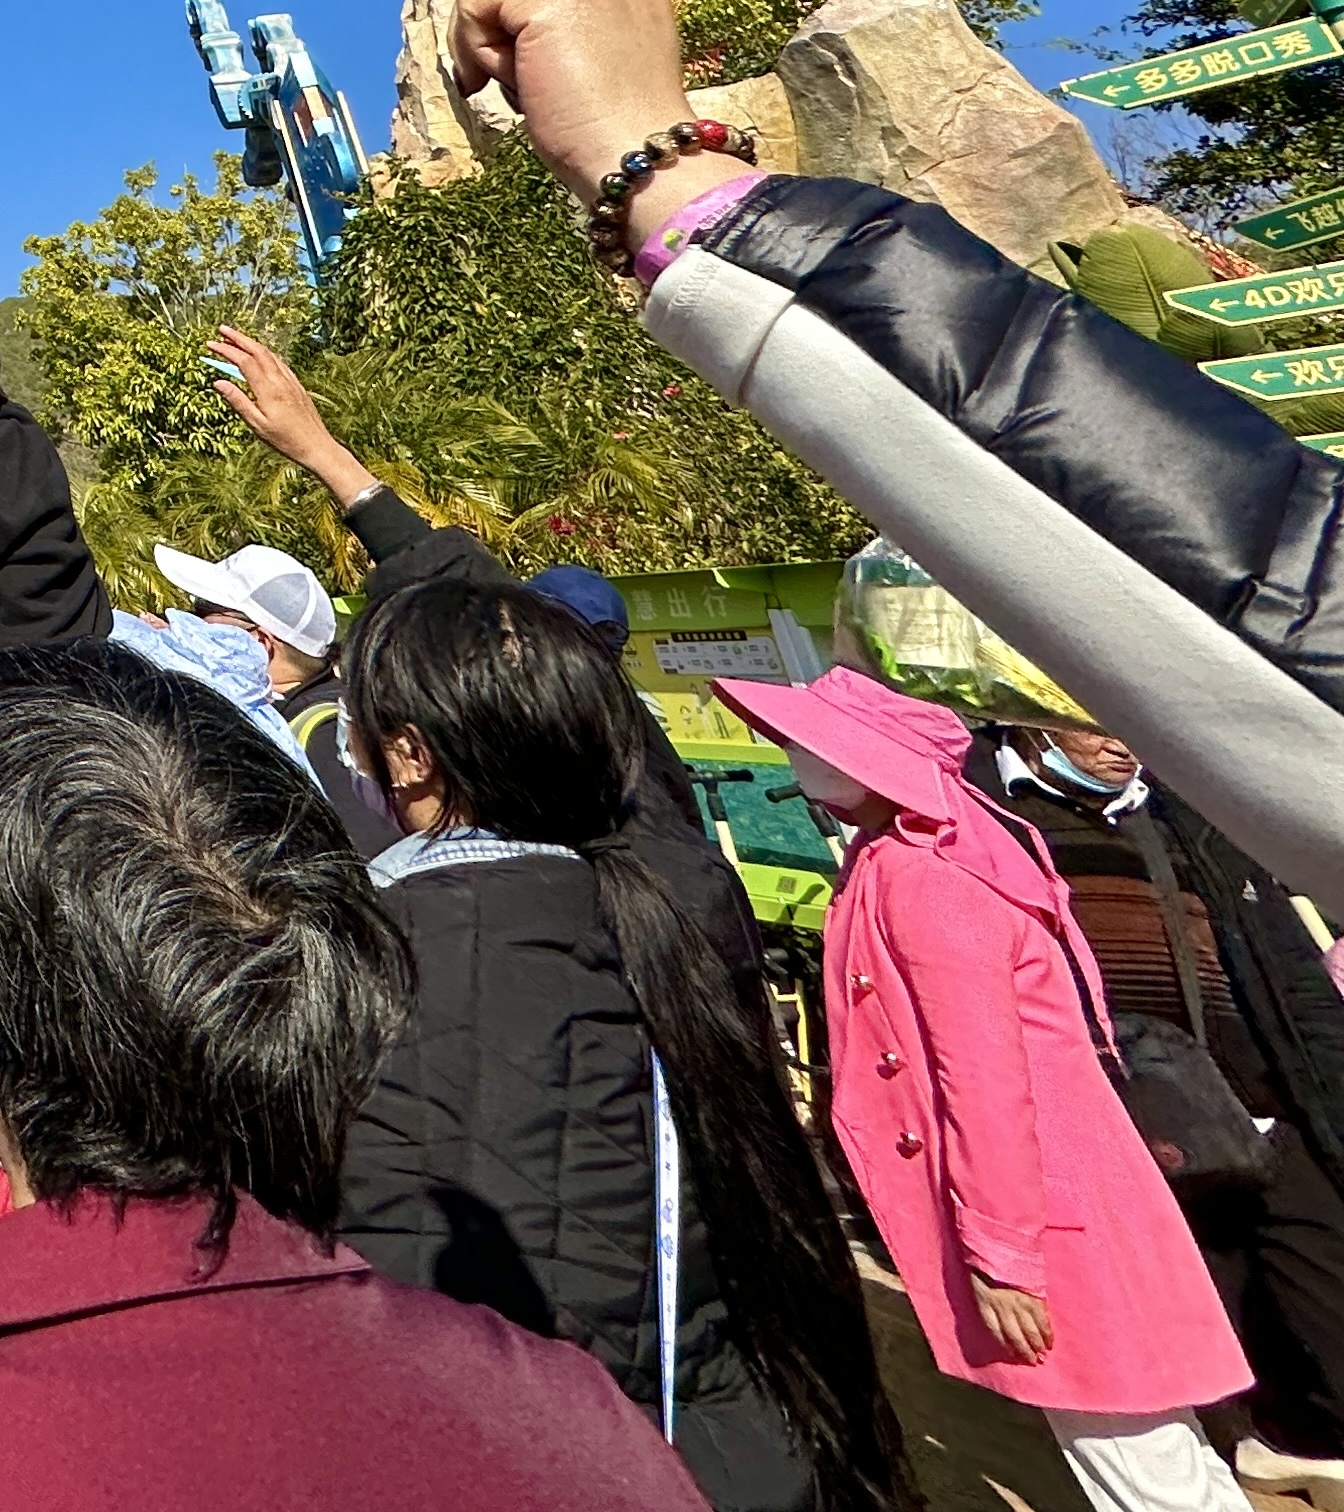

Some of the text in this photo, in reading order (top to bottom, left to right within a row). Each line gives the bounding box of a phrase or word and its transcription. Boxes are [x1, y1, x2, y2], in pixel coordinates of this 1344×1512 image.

[1133, 29, 1313, 94] 多多脱口秀
[1286, 197, 1344, 233] 飞越
[632, 587, 728, 621] 慧出行
